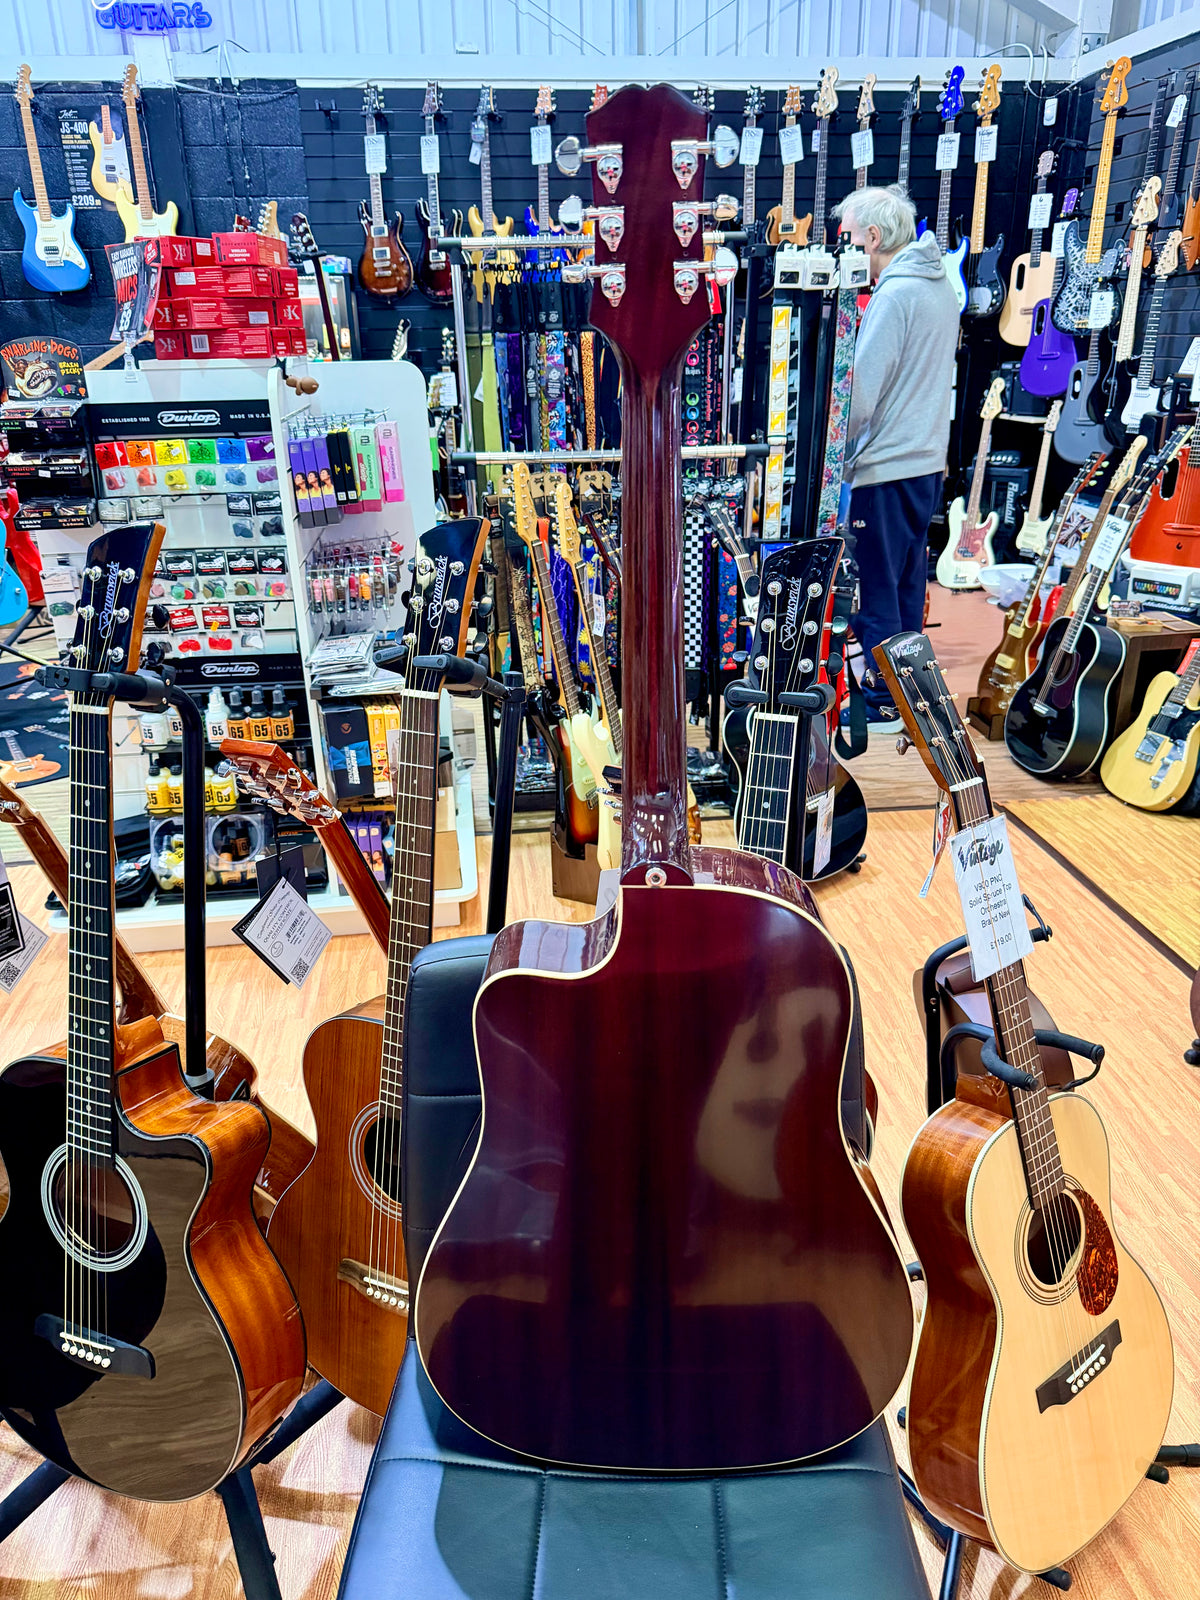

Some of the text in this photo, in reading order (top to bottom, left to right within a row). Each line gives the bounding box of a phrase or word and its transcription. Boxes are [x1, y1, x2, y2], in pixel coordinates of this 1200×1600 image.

[96, 2, 212, 31] GUITARS
[60, 122, 89, 134] JS-400
[112, 256, 138, 280] WIRELESS
[117, 275, 138, 304] MICS
[0, 340, 48, 361] SNARLING
[161, 413, 217, 424] Dunlop
[1004, 481, 1019, 525] Randall
[426, 555, 448, 629] Brunswick
[98, 561, 119, 639] Brunswick
[778, 577, 802, 651] Brunswick
[204, 665, 257, 675] Dunlop
[143, 729, 153, 739] 65
[212, 725, 224, 736] 65
[231, 727, 244, 739] 65
[254, 725, 268, 736] 65
[276, 725, 289, 736] 65
[169, 793, 181, 804] 65
[957, 833, 1004, 872] Vintage
[969, 895, 982, 908] Solid
[981, 914, 998, 928] Brand
